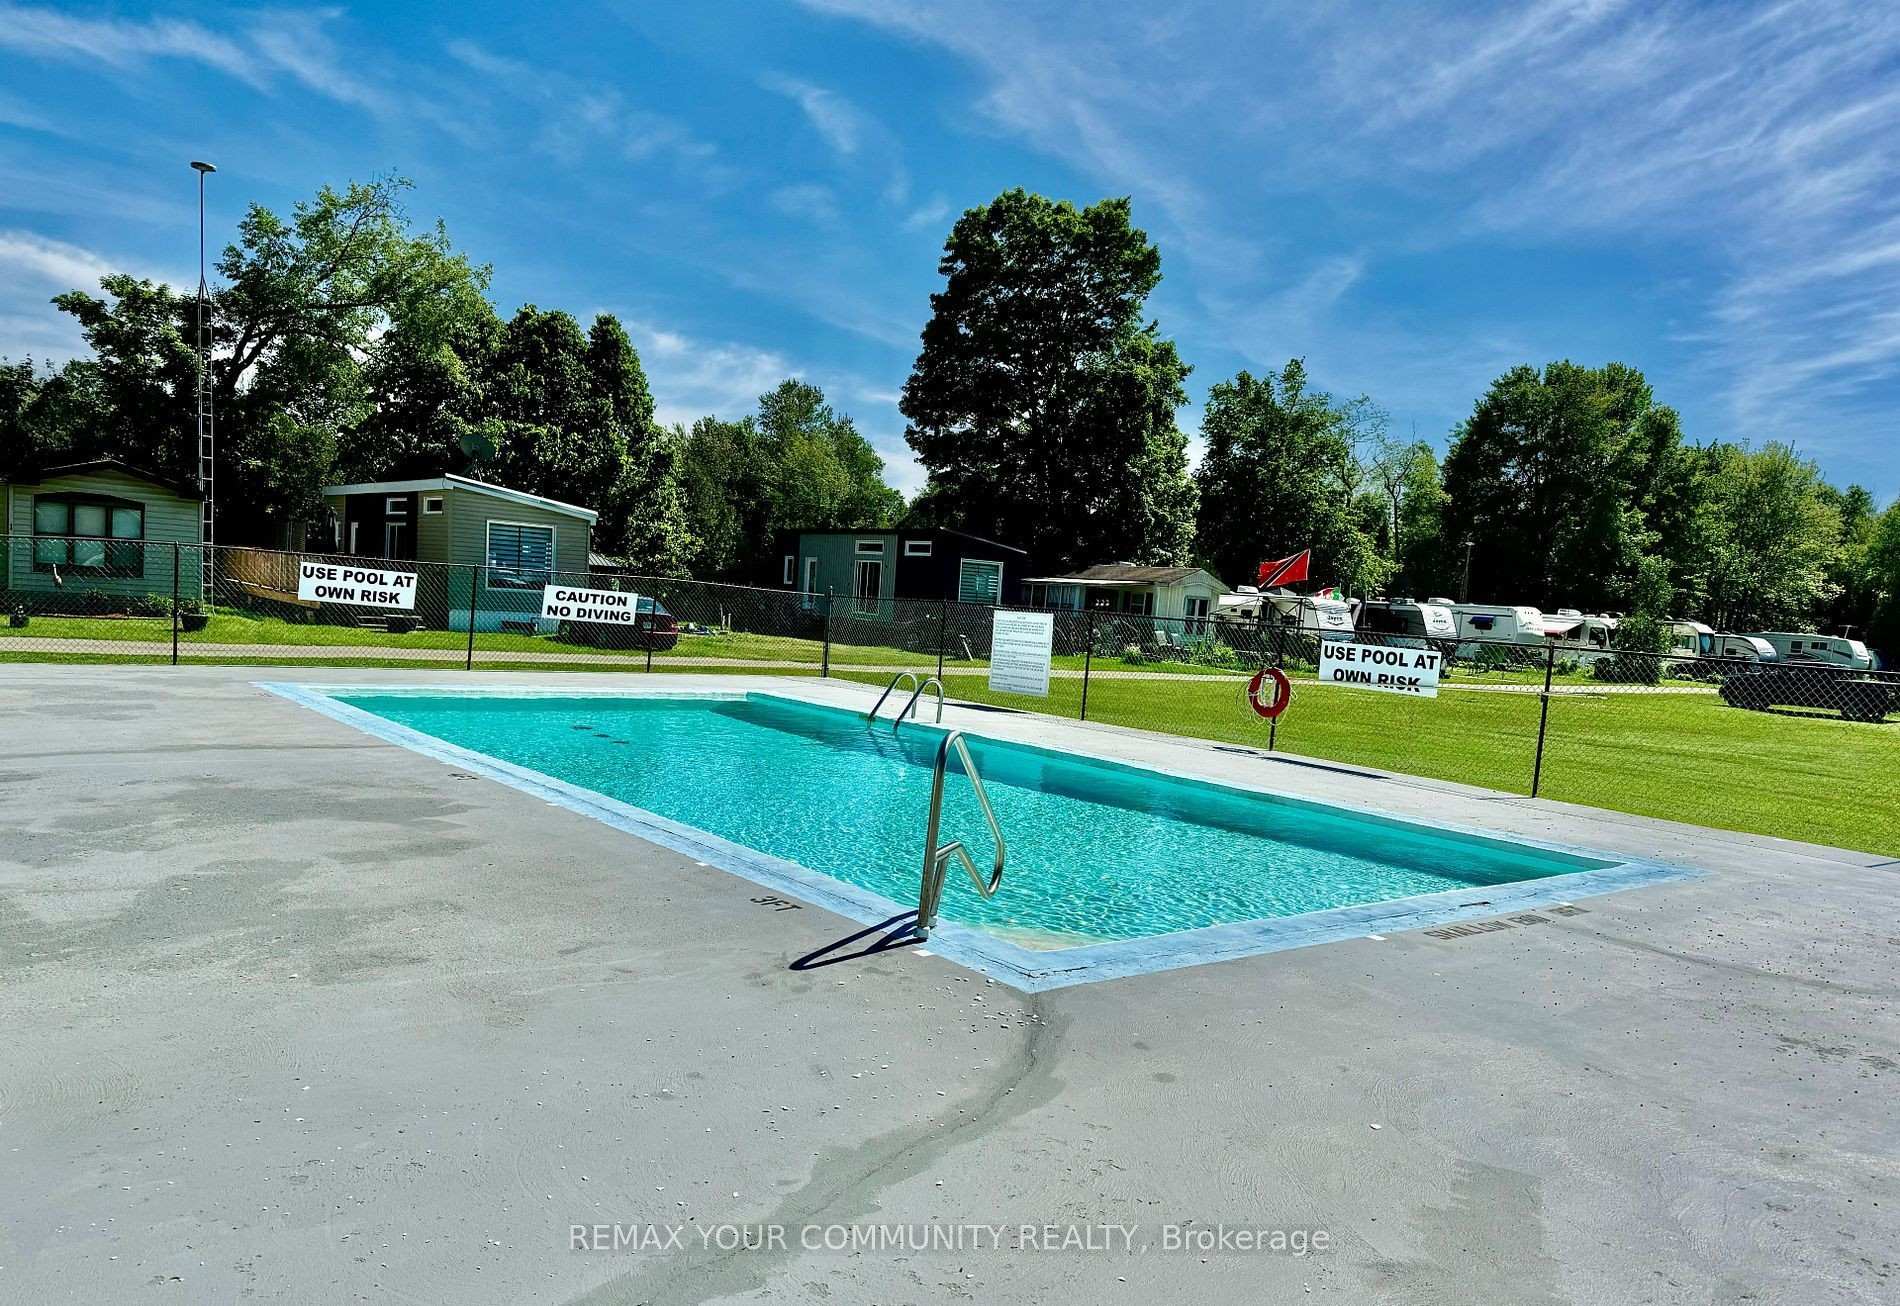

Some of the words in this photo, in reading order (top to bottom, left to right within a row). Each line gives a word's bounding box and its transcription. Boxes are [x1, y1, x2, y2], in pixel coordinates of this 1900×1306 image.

[302, 565, 338, 581] USE
[343, 569, 388, 586] POOL
[392, 575, 415, 588] AT
[314, 585, 355, 601] OWN
[360, 589, 401, 605] RISK
[555, 590, 628, 607] CAUTION
[546, 604, 571, 617] NO
[576, 607, 631, 622] DIVING
[1323, 645, 1357, 662] USE
[1361, 648, 1409, 668] POOL
[1413, 654, 1439, 670] AT
[1333, 668, 1372, 686] OWN
[1377, 673, 1421, 693] RISK
[750, 895, 803, 912] 3FT
